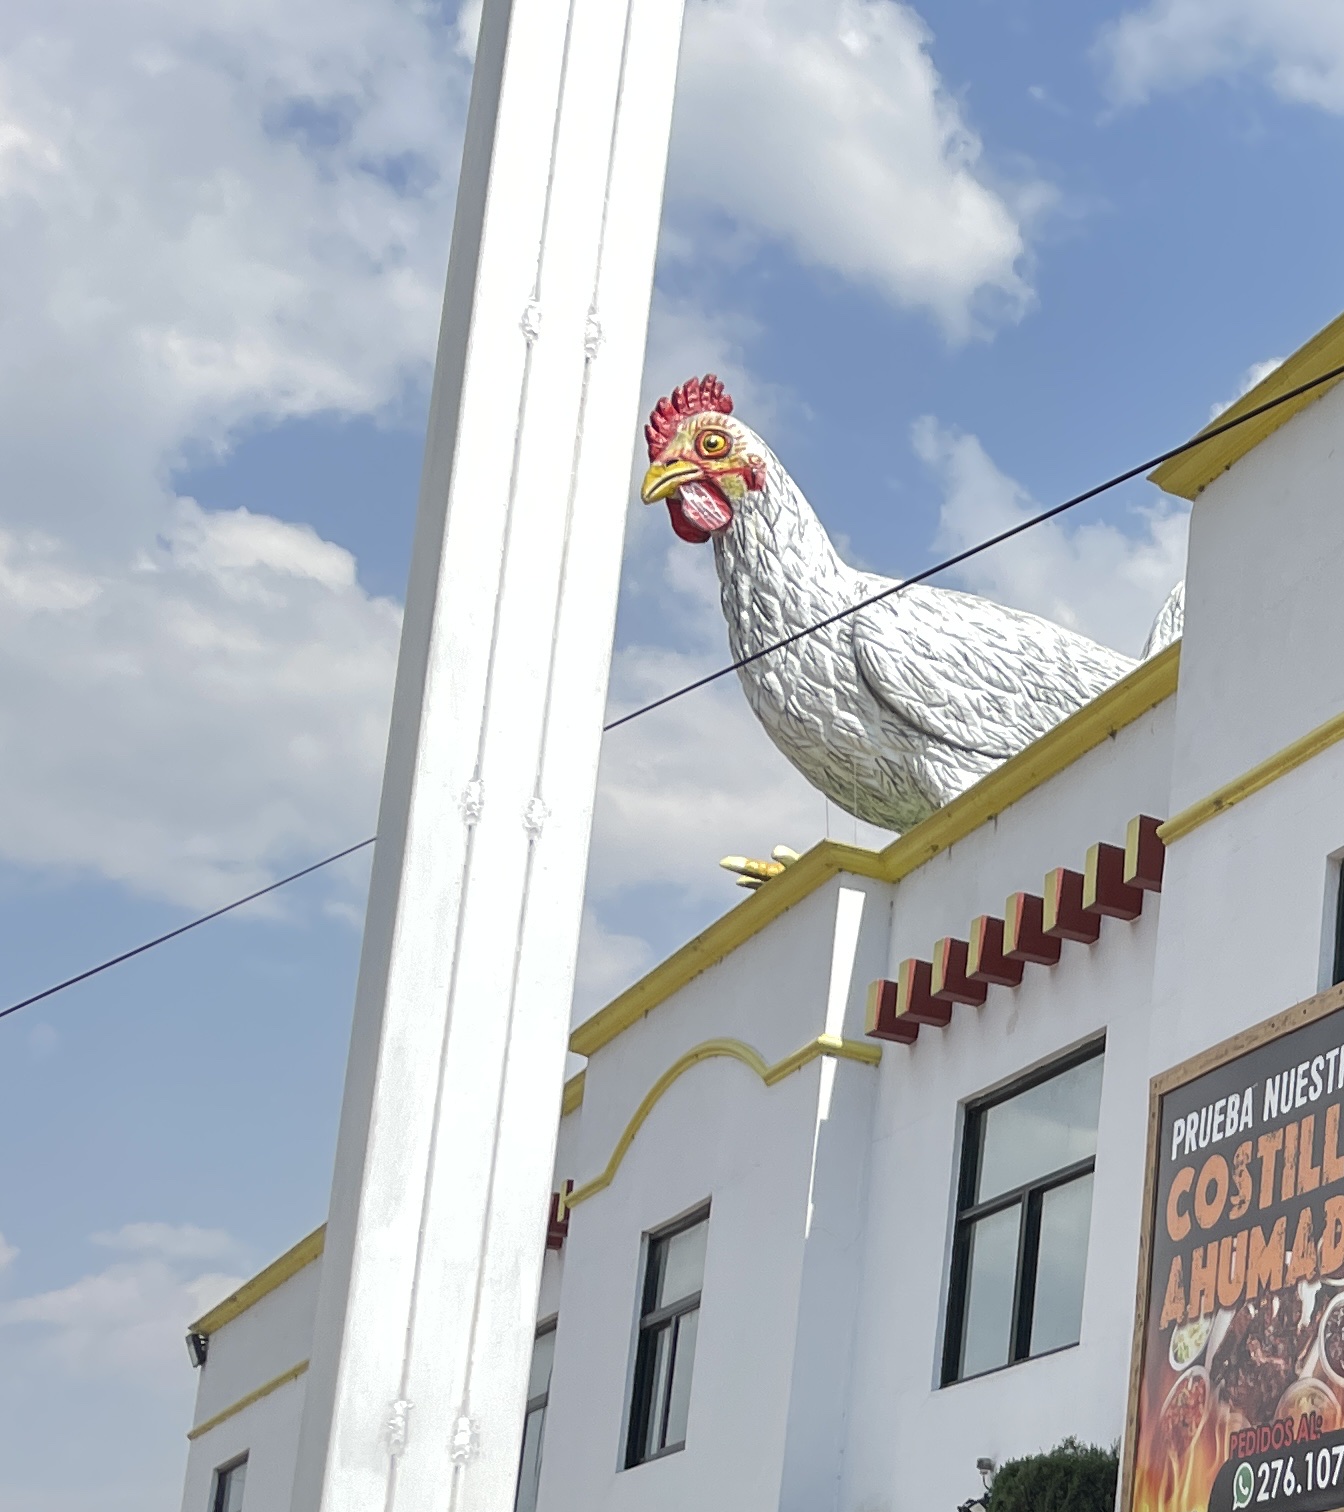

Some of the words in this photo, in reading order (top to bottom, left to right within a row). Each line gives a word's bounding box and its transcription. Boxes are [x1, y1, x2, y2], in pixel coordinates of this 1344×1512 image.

[1171, 1087, 1253, 1160] PRUEBA
[1230, 1416, 1293, 1458] PEDIDOS
[1298, 1411, 1323, 1442] AL:
